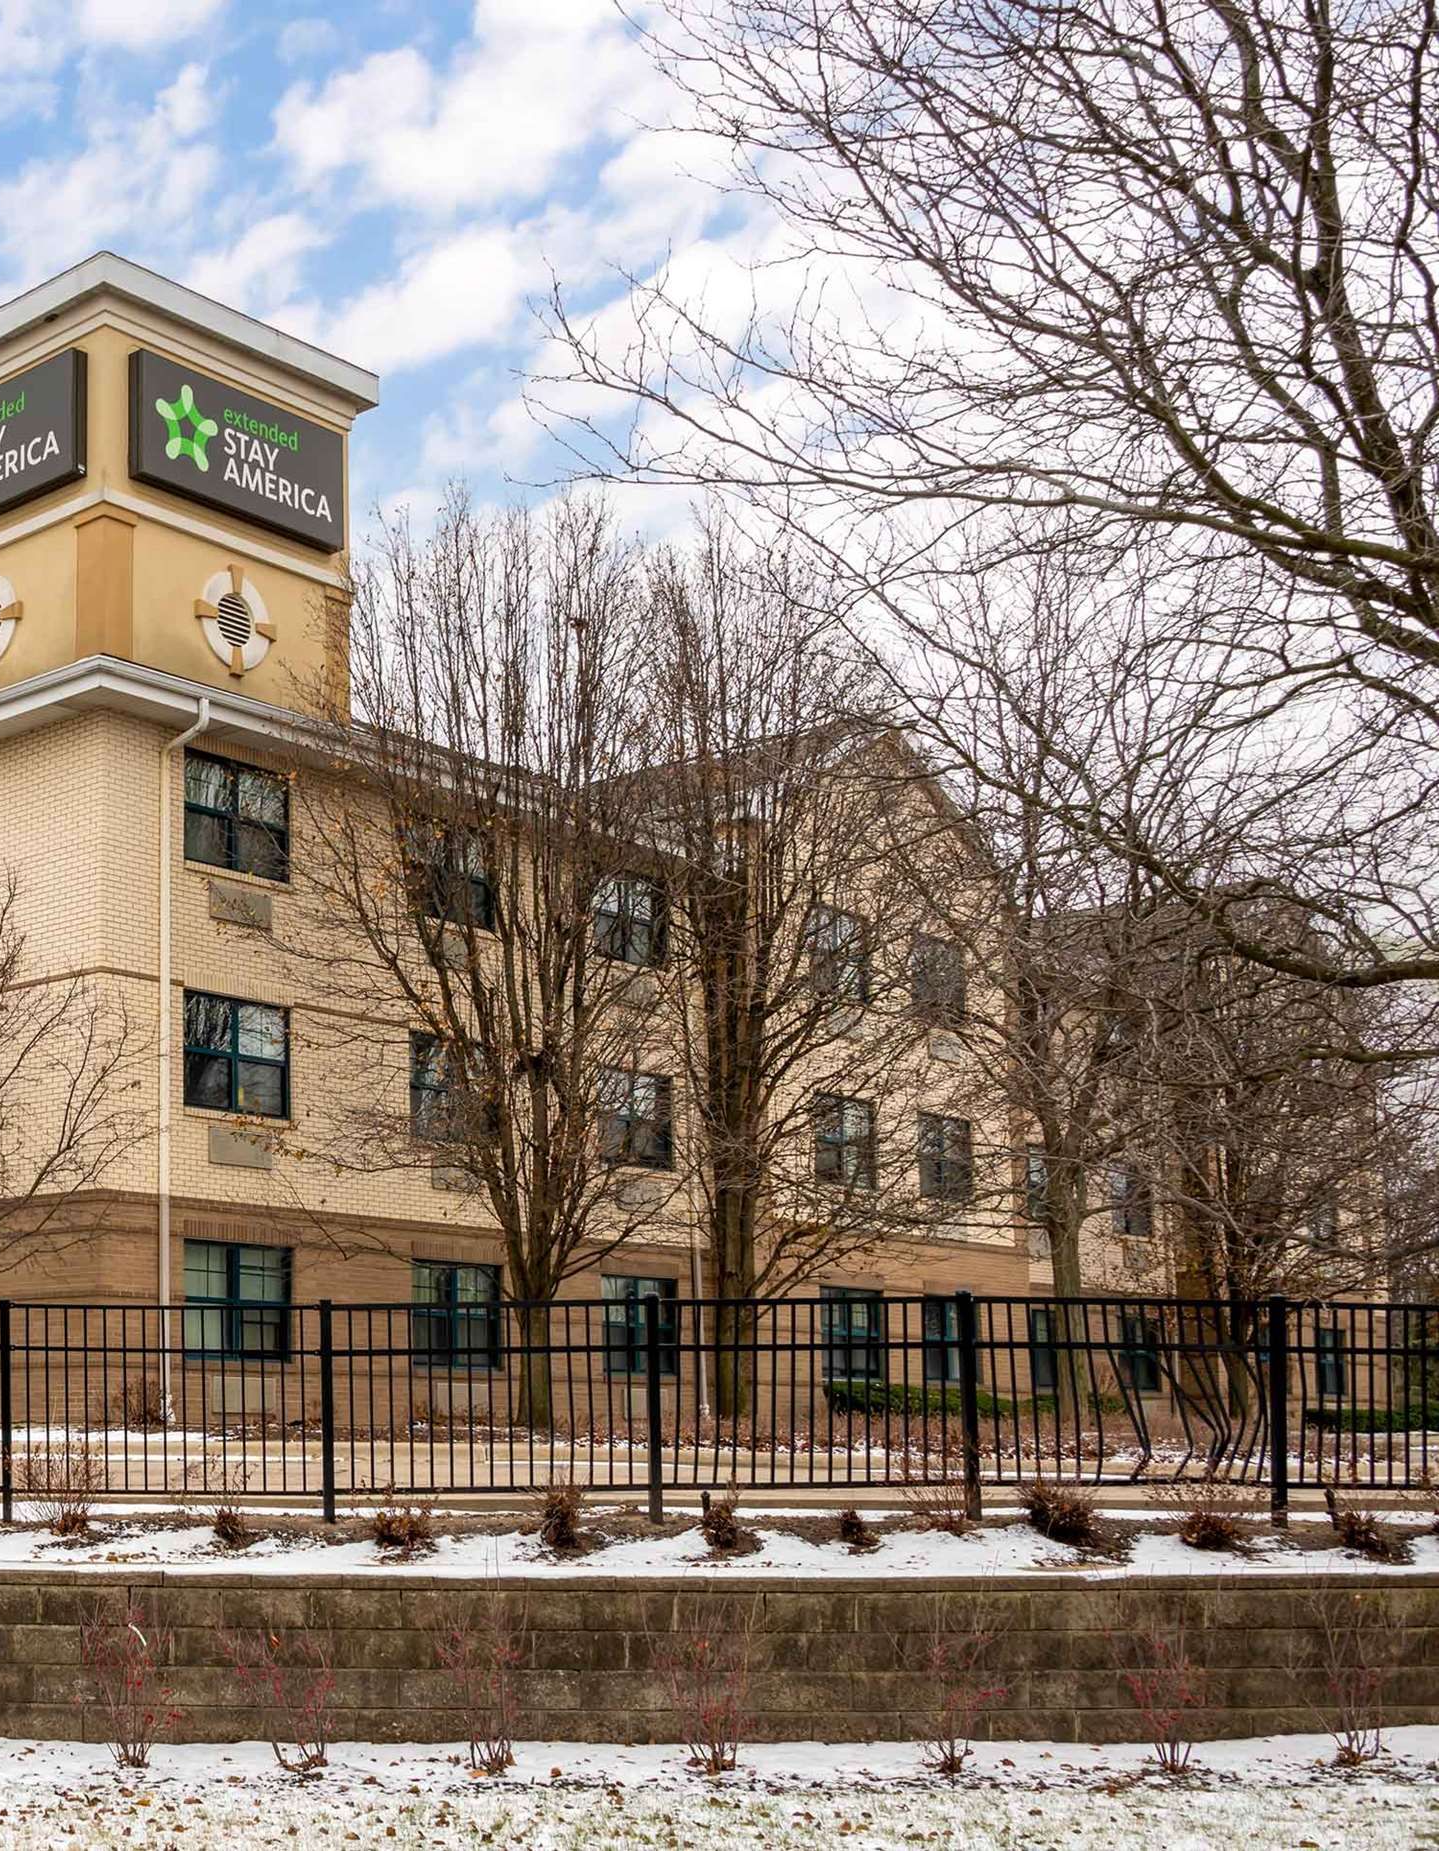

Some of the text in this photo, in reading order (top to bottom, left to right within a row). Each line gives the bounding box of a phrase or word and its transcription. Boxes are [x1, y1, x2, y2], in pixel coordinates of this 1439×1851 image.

[223, 408, 298, 452] extended
[223, 428, 280, 472] STAY
[223, 458, 333, 523] AMERICA
